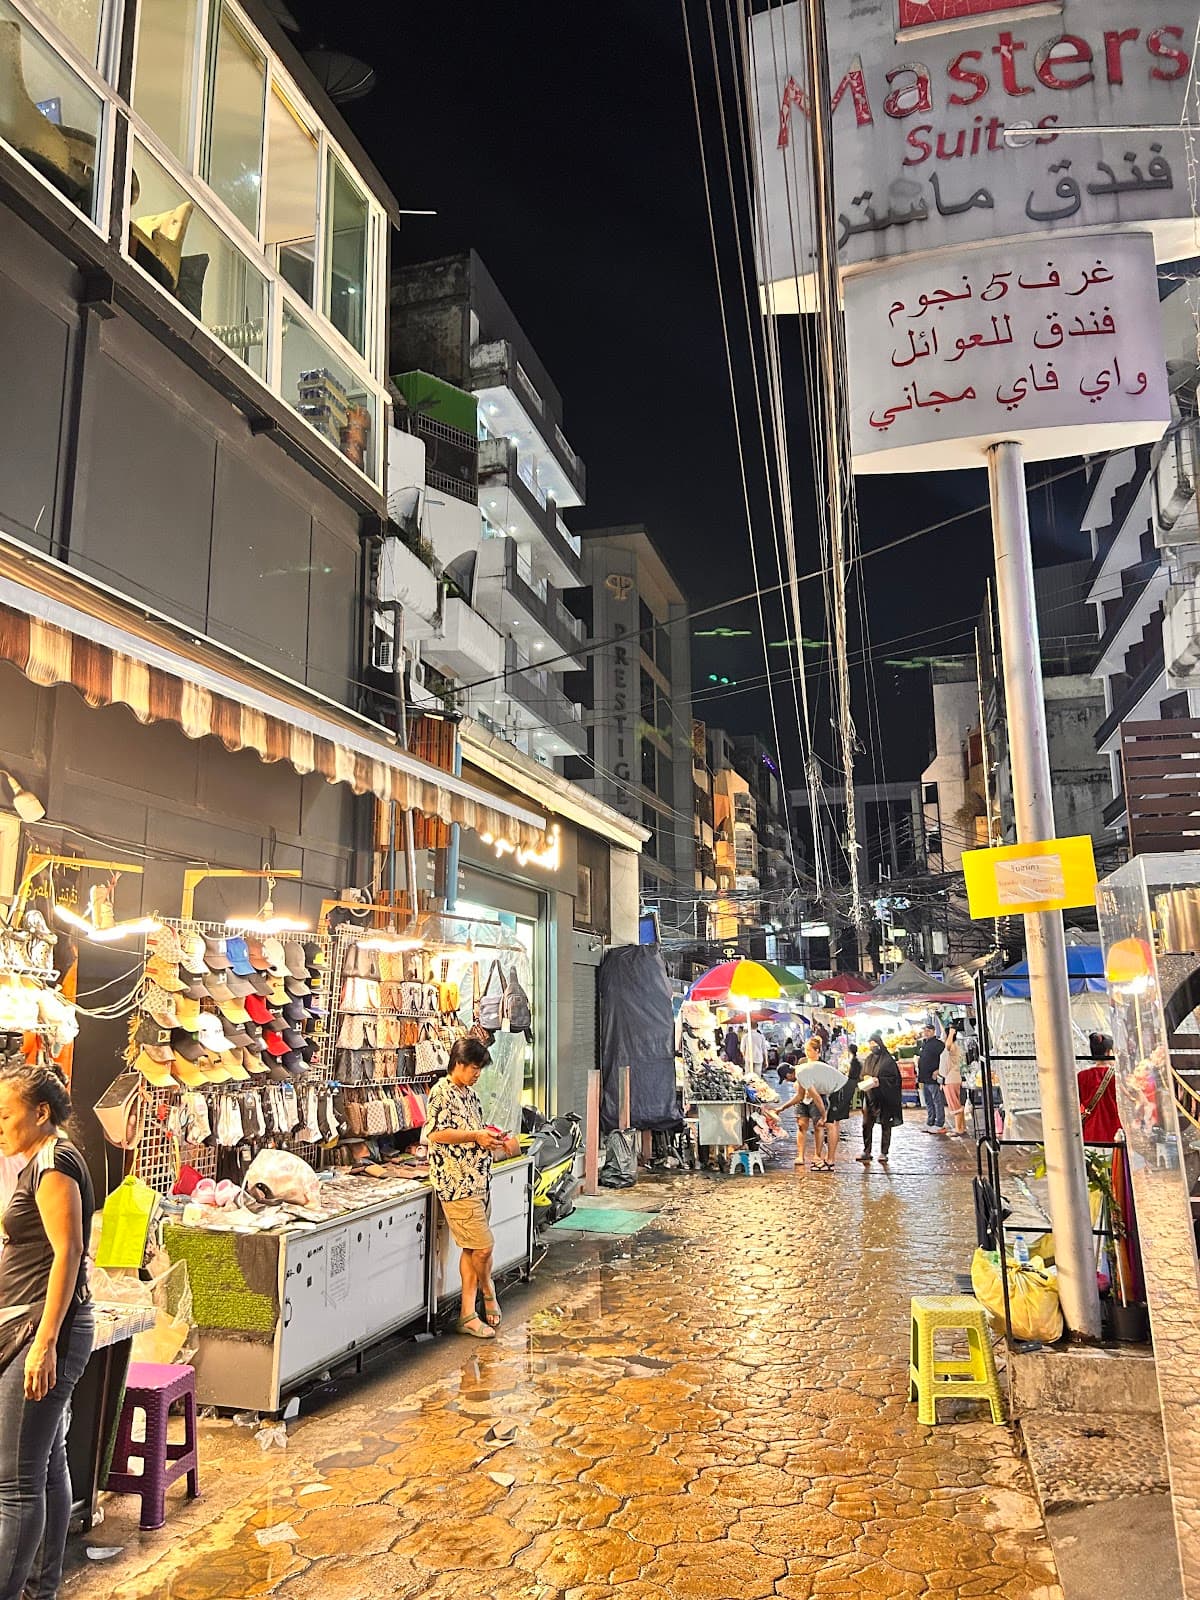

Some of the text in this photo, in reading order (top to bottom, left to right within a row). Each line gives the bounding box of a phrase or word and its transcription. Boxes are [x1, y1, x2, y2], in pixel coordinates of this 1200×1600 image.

[777, 24, 1189, 150] Masters
[903, 113, 1059, 167] Suites
[1025, 143, 1174, 222] فندق
[888, 259, 1114, 327] غرف 5 نجوم
[891, 305, 1116, 368] فندق للعوائل
[869, 356, 1148, 432] واي فاي مجاني
[613, 623, 631, 806] PRESTIGE
